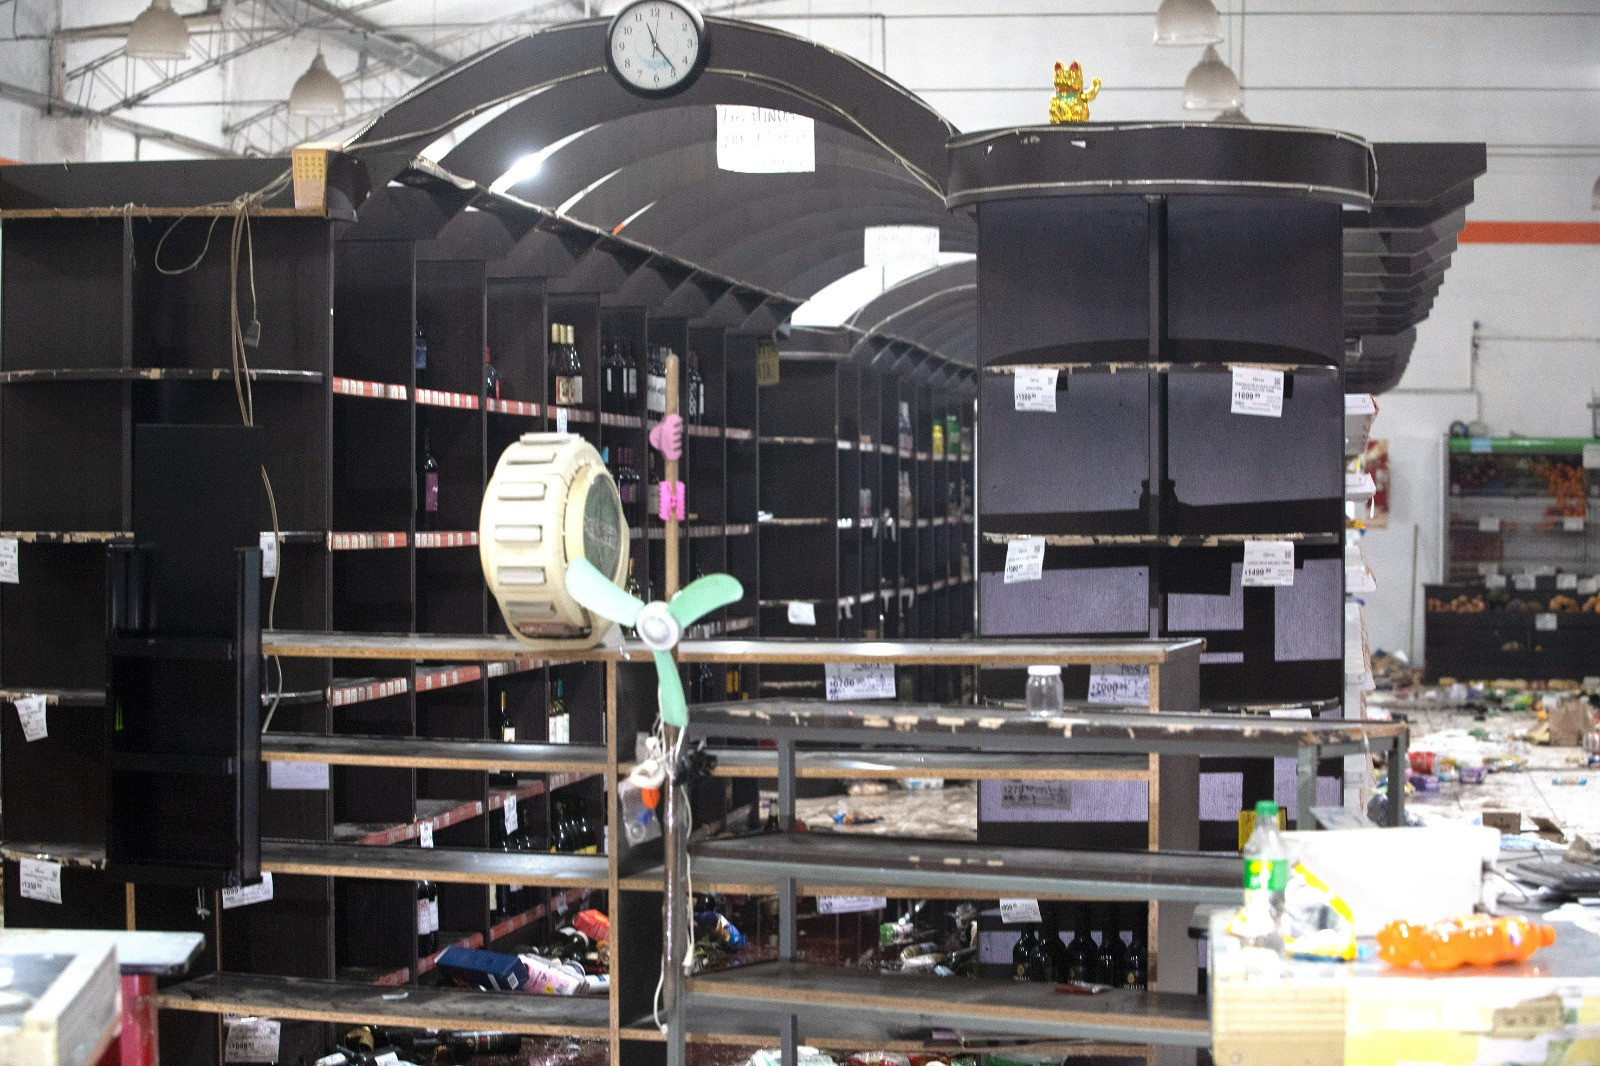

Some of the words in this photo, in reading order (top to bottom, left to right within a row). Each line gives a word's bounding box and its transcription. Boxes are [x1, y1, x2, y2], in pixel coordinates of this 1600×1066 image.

[635, 13, 642, 22] 11
[650, 7, 660, 18] 12
[624, 25, 632, 36] 10
